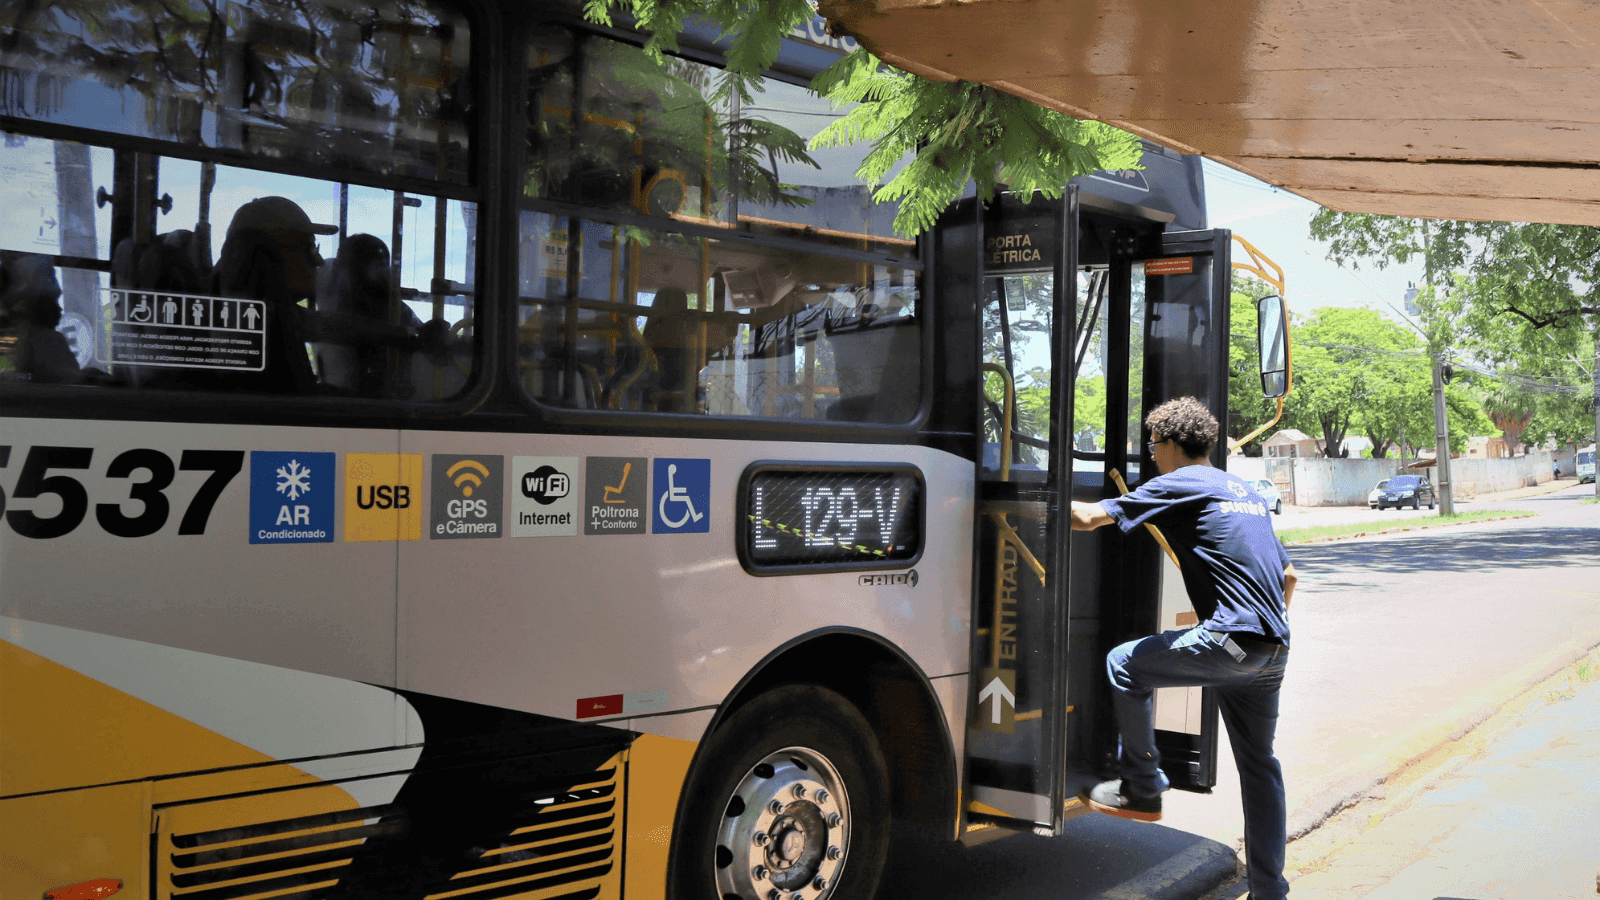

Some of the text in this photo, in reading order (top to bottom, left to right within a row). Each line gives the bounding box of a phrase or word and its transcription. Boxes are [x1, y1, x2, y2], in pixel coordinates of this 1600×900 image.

[987, 234, 1032, 249] PORTA
[356, 485, 410, 510] USB
[275, 505, 310, 525] AR
[447, 499, 488, 518] GPS
[592, 505, 639, 518] Poltrona
[519, 512, 571, 525] Internet
[755, 487, 900, 548] L 129-V
[258, 529, 326, 539] Condicionado
[859, 575, 906, 586] CAIO
